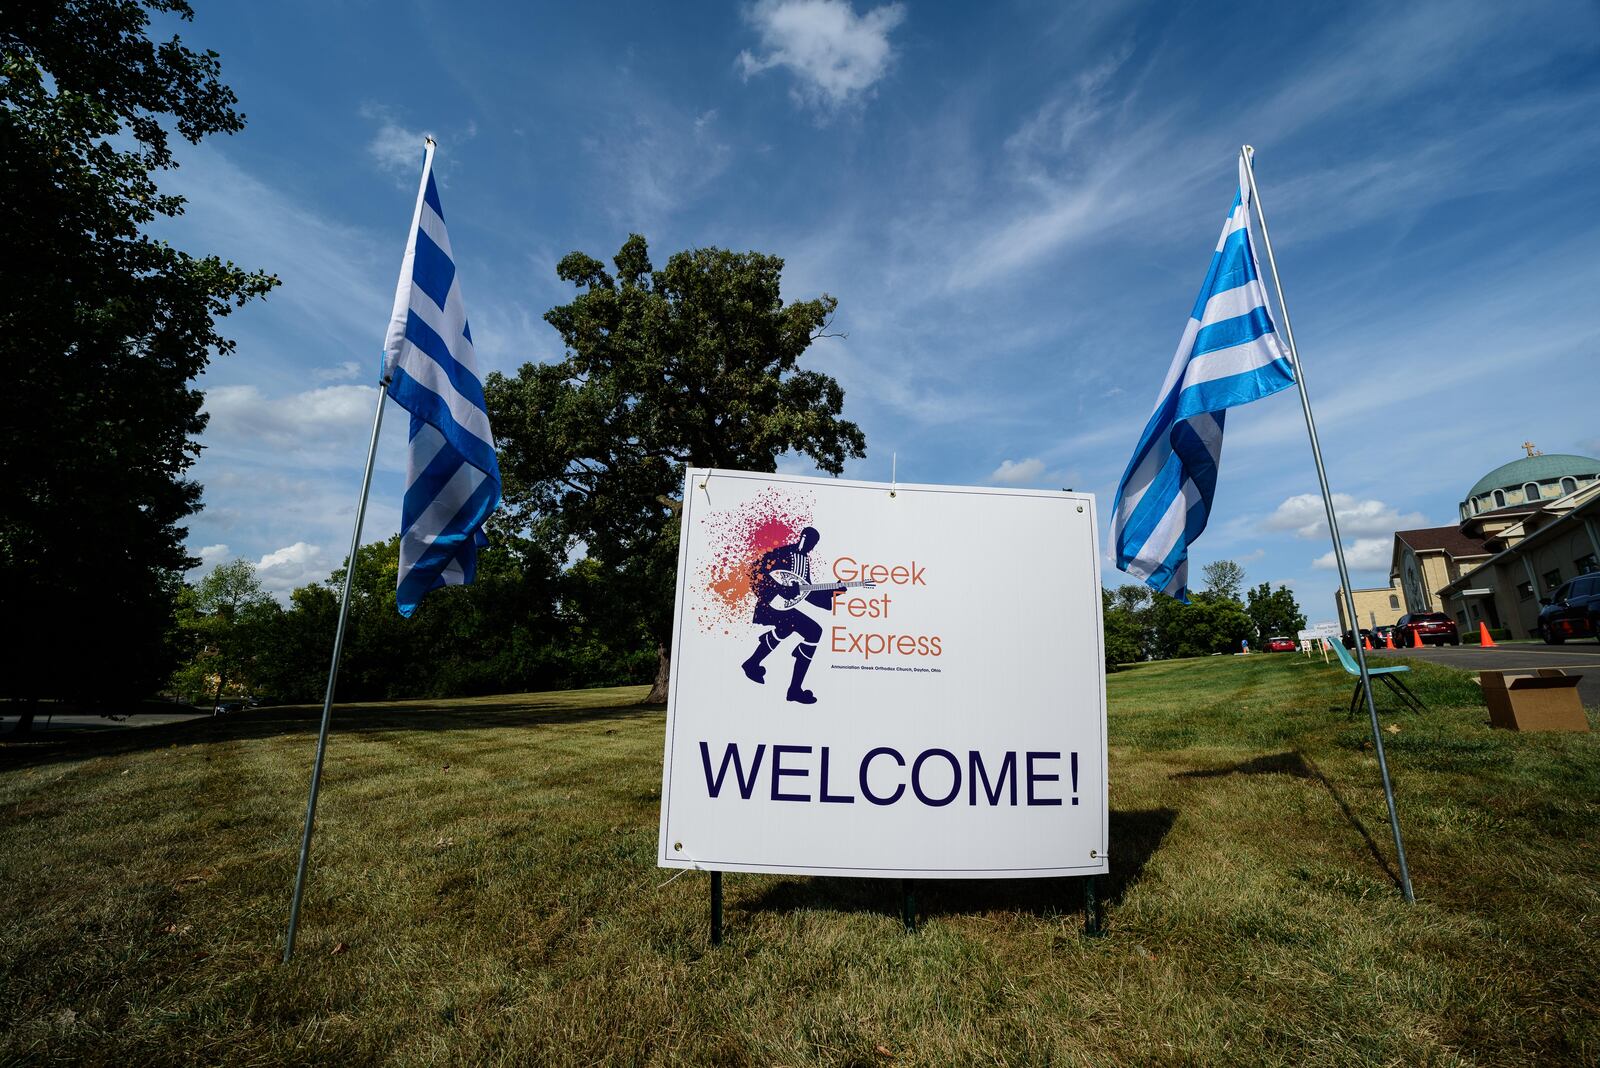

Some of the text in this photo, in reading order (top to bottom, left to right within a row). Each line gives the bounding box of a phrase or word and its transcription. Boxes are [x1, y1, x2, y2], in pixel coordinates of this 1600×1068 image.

[833, 557, 927, 586] Greek
[832, 590, 892, 618] Fest
[831, 626, 942, 660] Express
[699, 741, 1079, 807] WELCOME!
